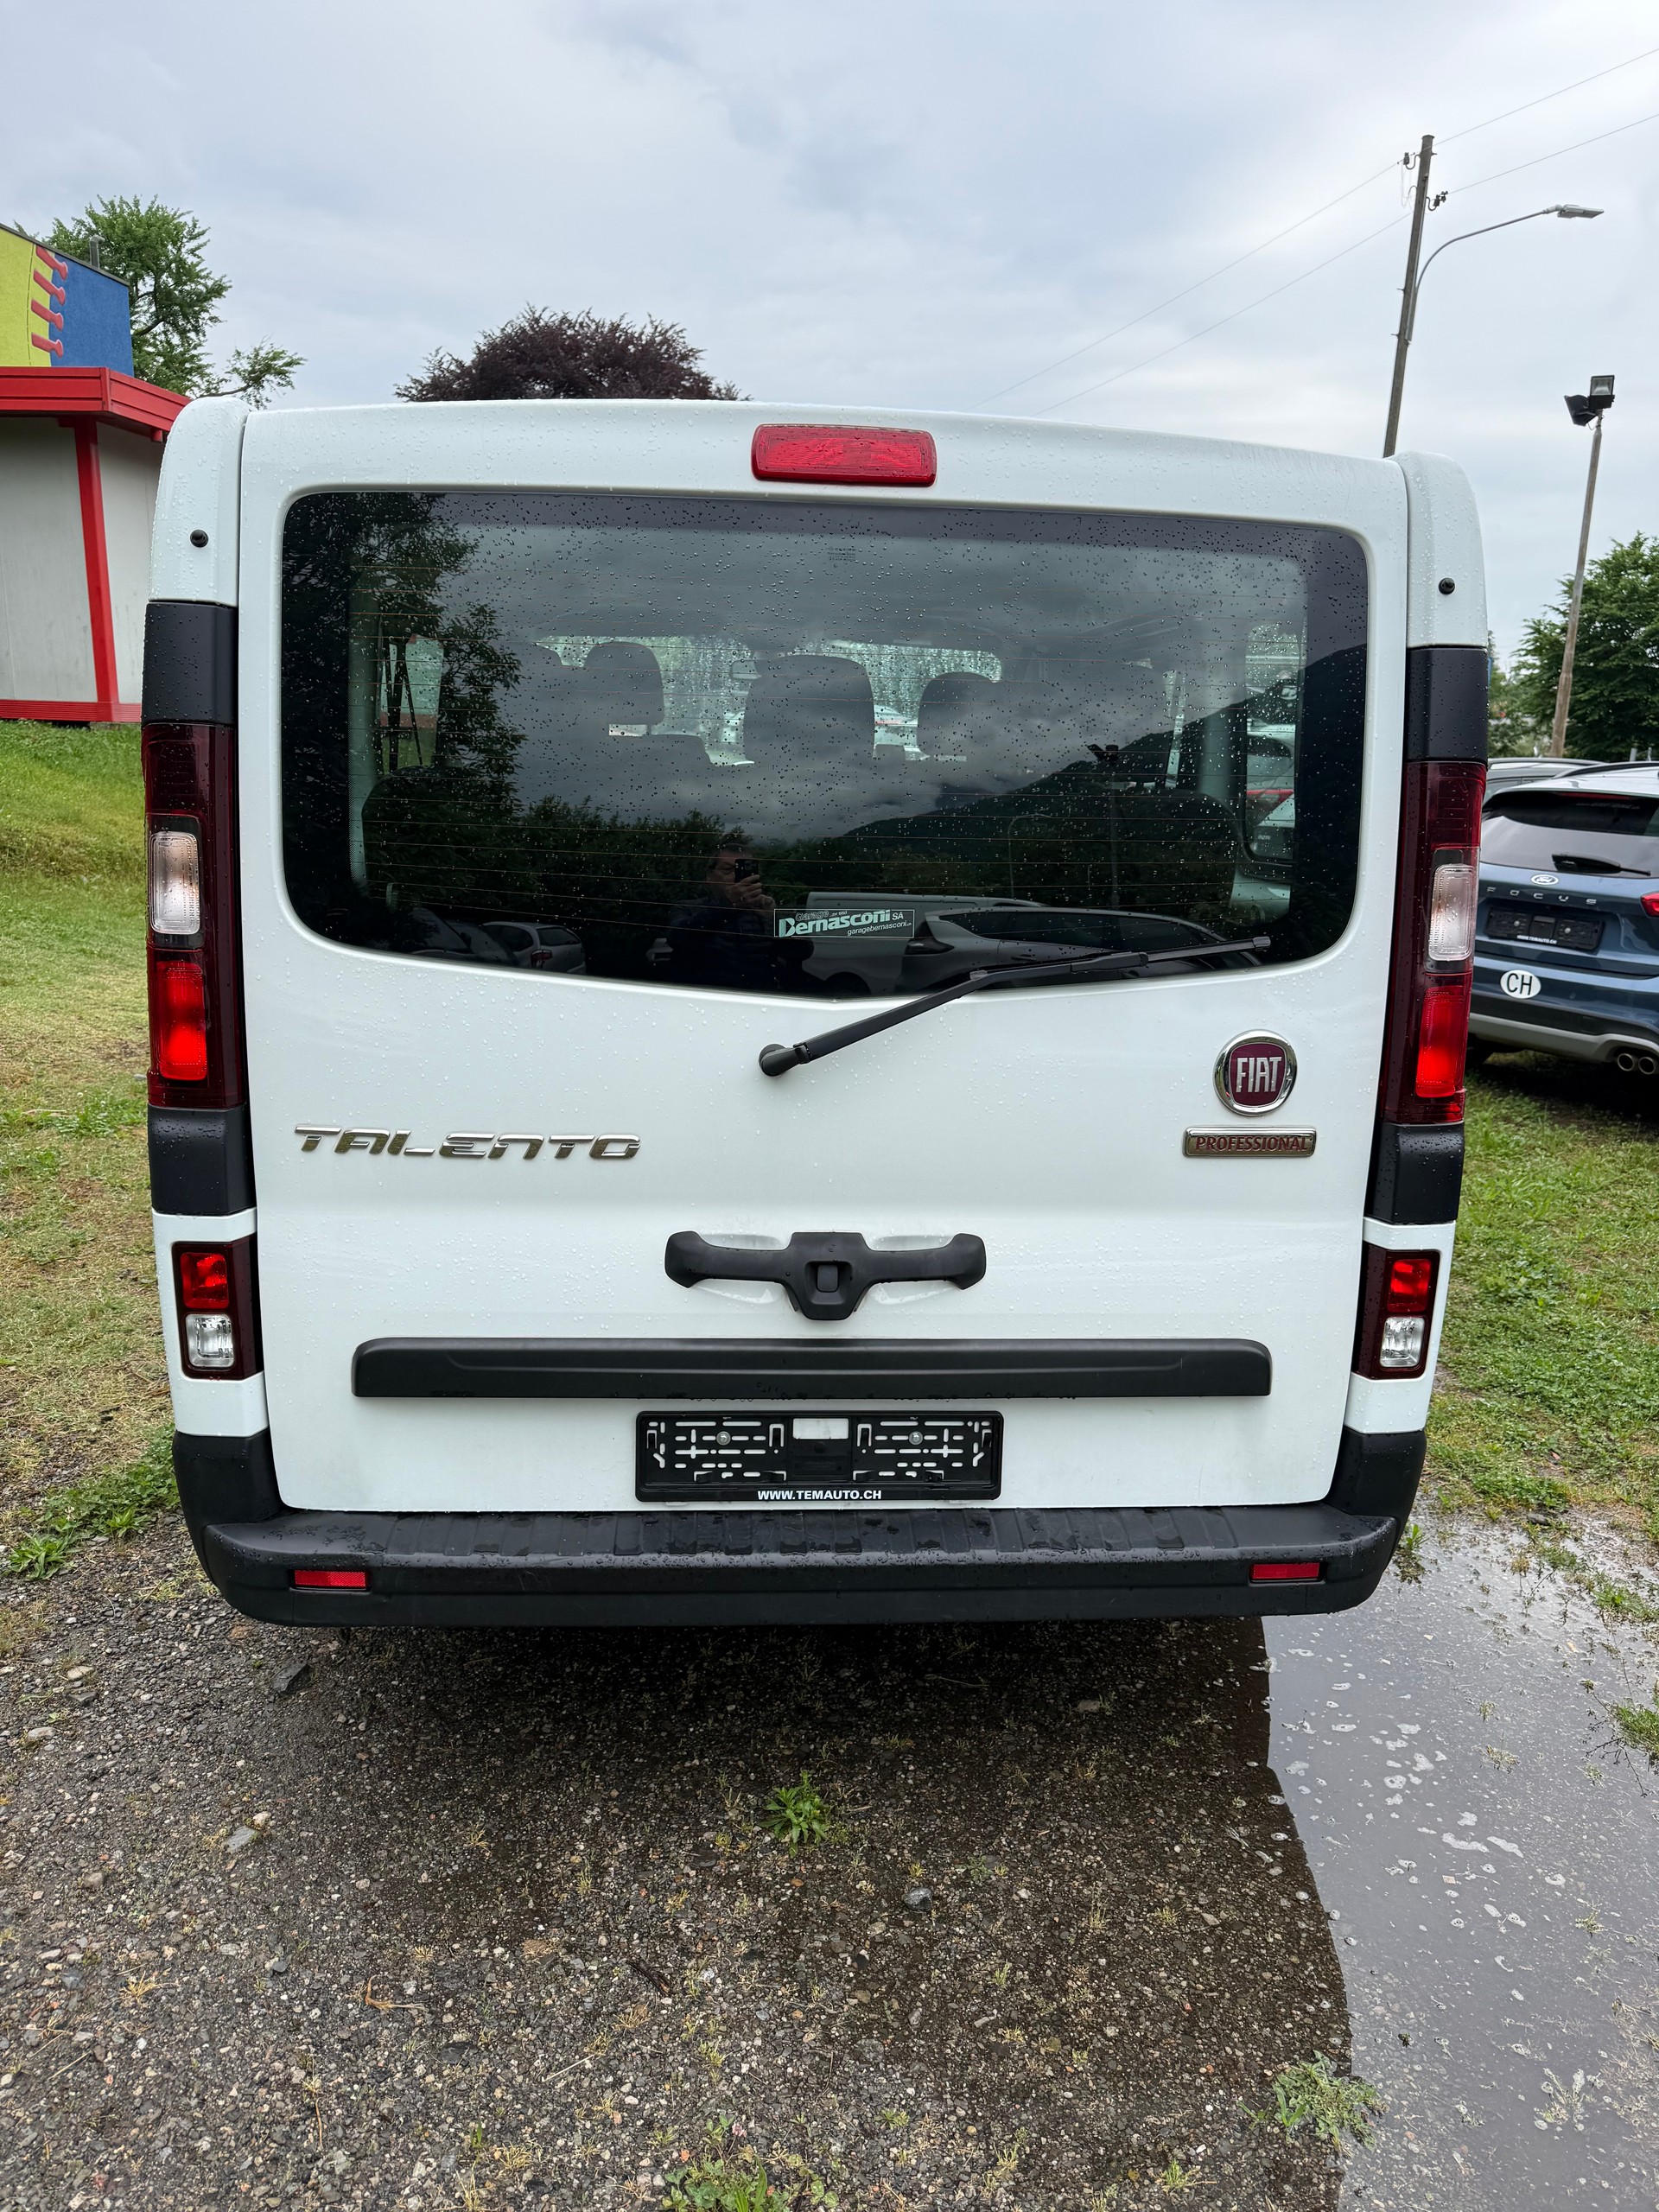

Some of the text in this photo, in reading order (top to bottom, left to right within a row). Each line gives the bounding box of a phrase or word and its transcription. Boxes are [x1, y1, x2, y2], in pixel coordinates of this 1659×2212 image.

[1487, 887, 1597, 906] FOCUS
[779, 909, 905, 938] Bernasconi SA
[795, 910, 830, 922] Garage
[1506, 972, 1533, 996] CH
[1236, 1056, 1282, 1093] FIAT
[294, 1124, 641, 1160] TALENTO
[1195, 1135, 1309, 1152] PROFESSIONAL
[757, 1490, 882, 1500] WWW.TEMAUTO.CH
